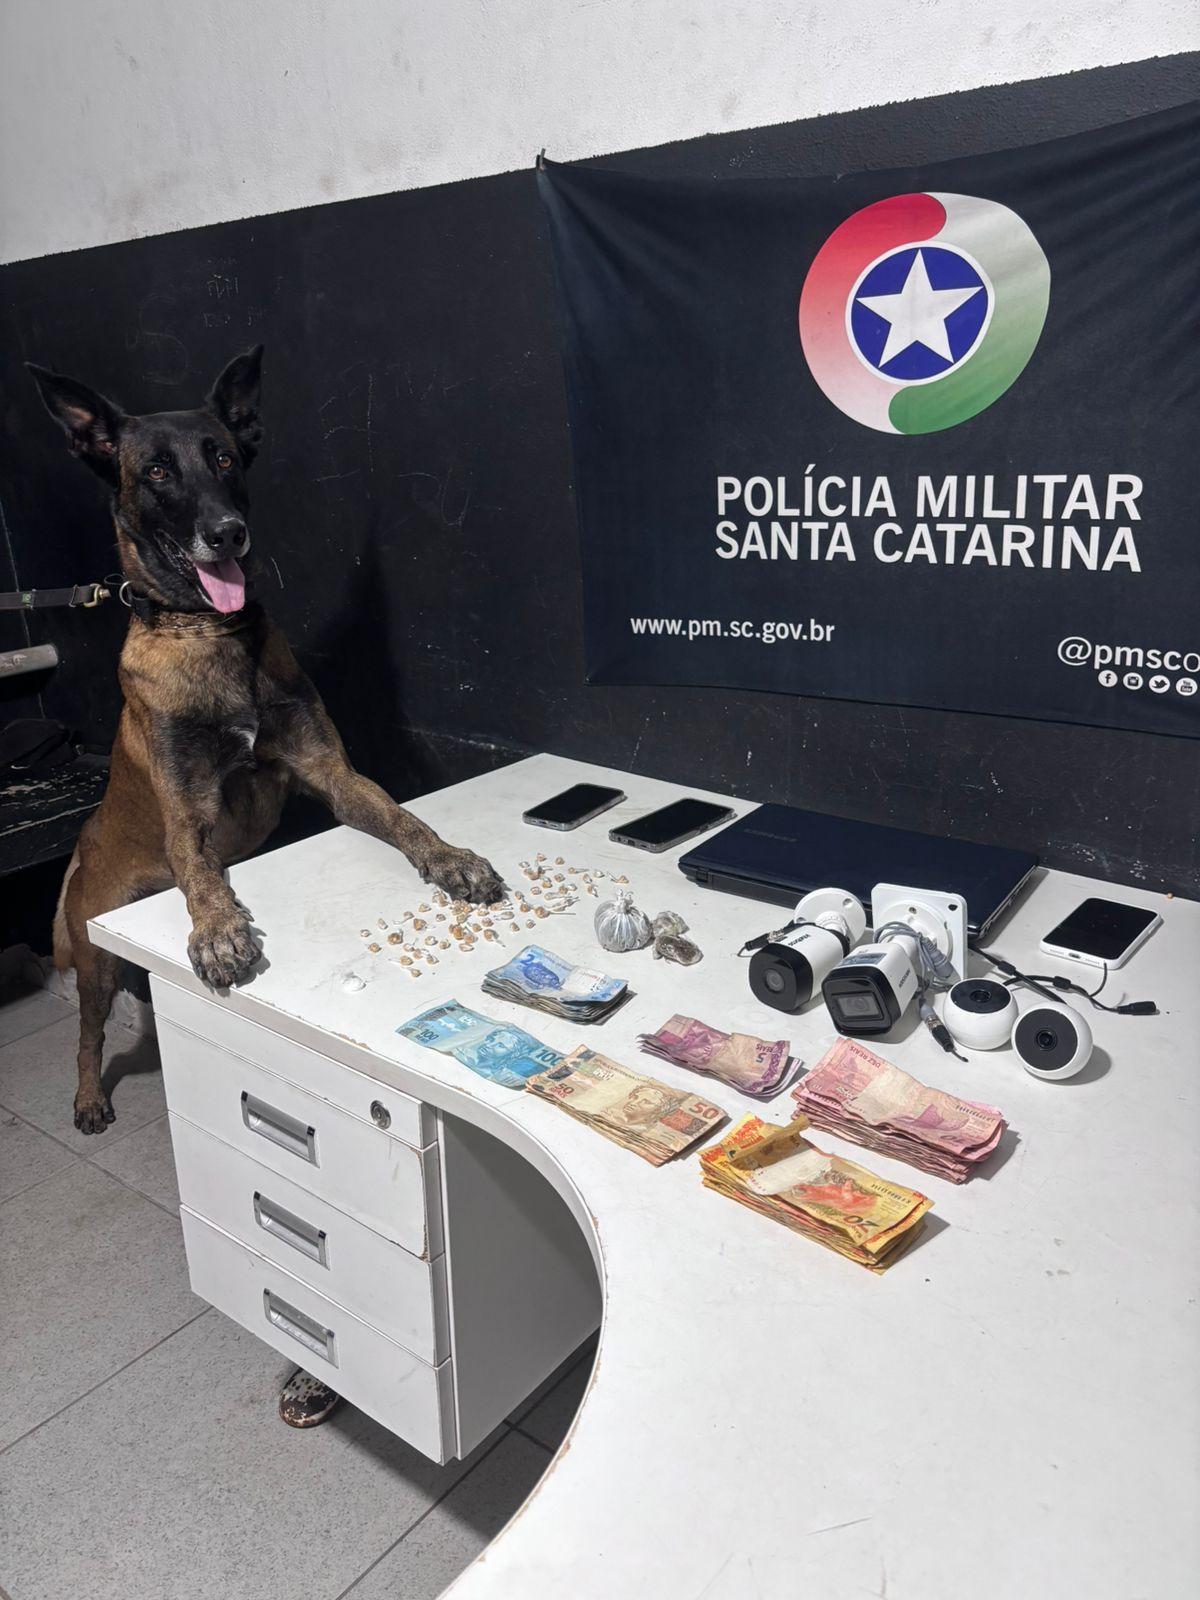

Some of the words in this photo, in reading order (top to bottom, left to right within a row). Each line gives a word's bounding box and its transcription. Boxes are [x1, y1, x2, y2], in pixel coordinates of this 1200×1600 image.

[717, 464, 897, 518] POLÍCIA
[916, 474, 1144, 521] MILITAR
[715, 521, 857, 562] SANTA
[873, 523, 1142, 573] CATARINA
[630, 617, 835, 642] www.pm.sc.gov.br
[1057, 636, 1200, 673] @pmsco
[420, 1028, 440, 1041] 100
[756, 1052, 768, 1064] 5
[558, 1083, 575, 1095] 50
[688, 1102, 720, 1120] 50
[842, 1215, 881, 1234] 20
